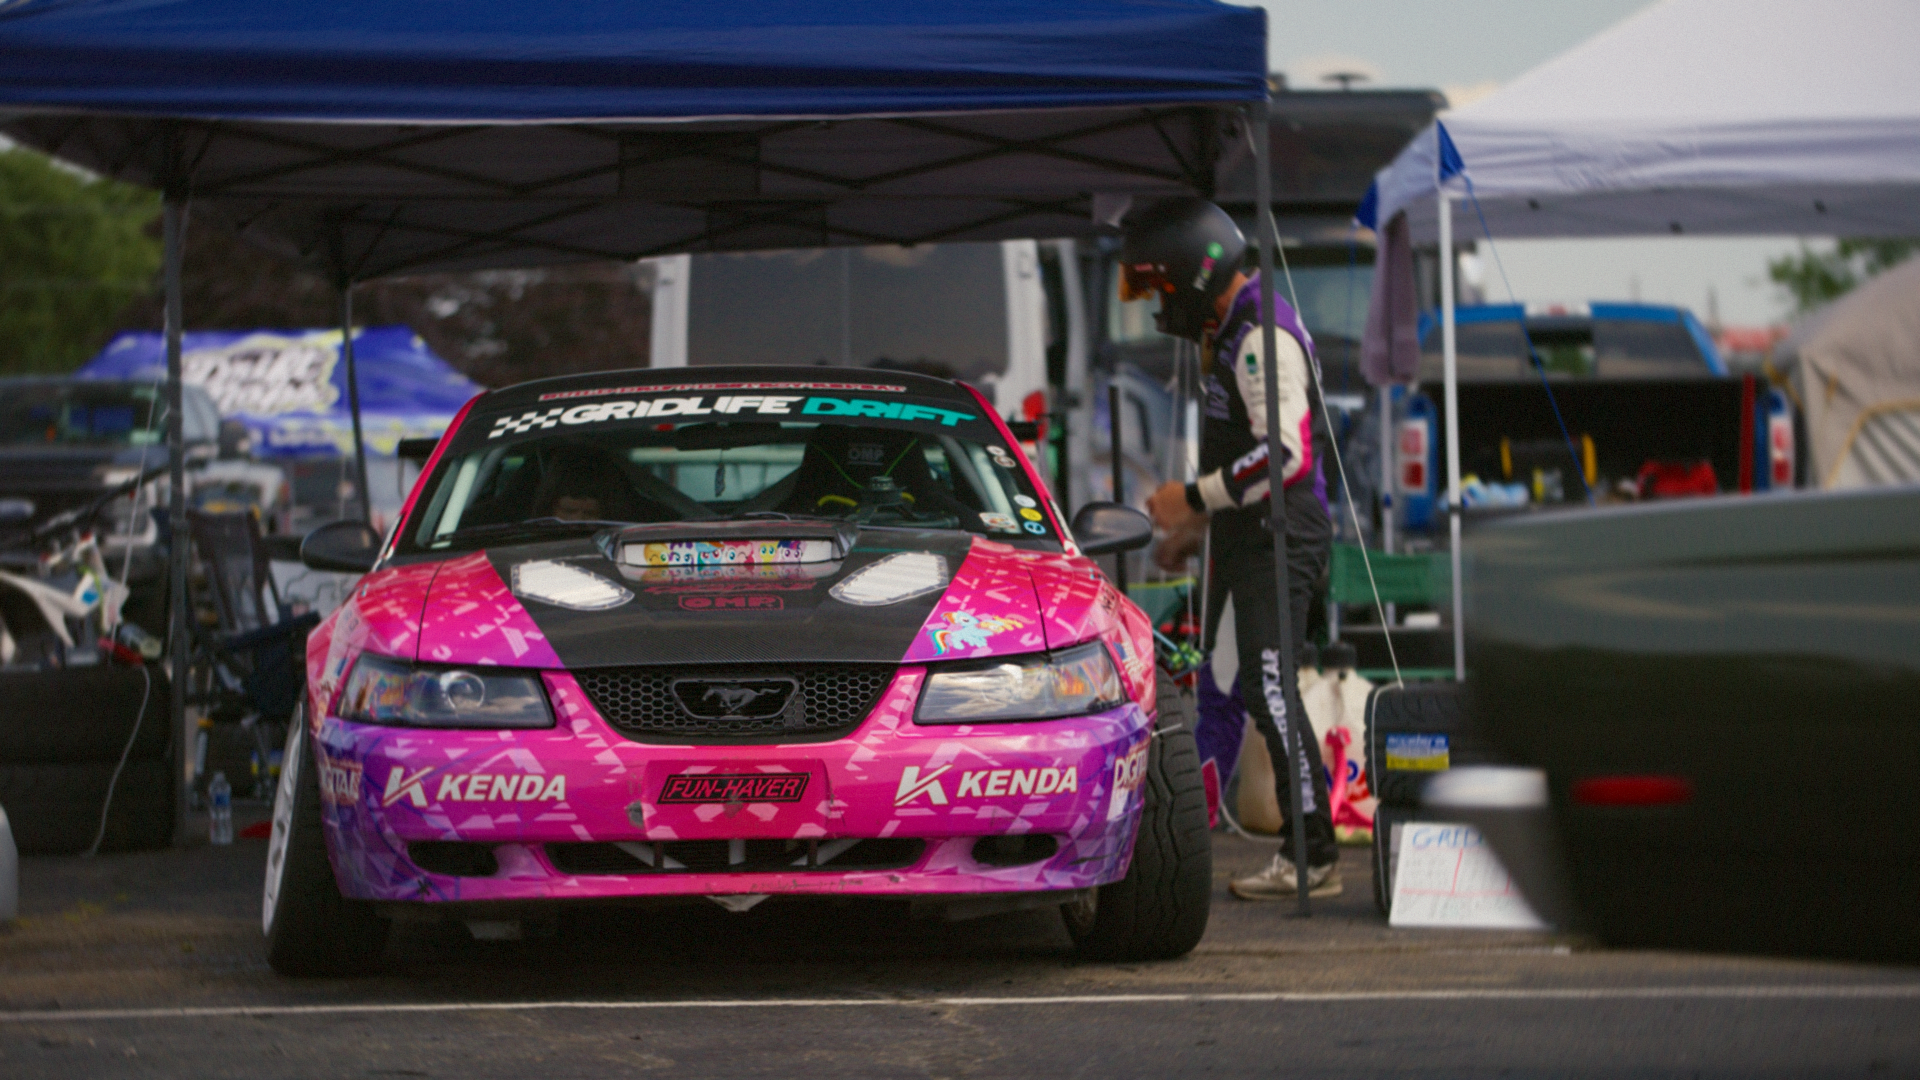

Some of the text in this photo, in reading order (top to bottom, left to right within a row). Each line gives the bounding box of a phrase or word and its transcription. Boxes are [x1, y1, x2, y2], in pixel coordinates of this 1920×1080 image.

[560, 396, 977, 427] GRIDLIFE DRIFT
[684, 596, 777, 608] OMP
[436, 774, 567, 801] KENDA
[667, 778, 801, 799] FUN-HAVER
[956, 766, 1077, 798] KENDA
